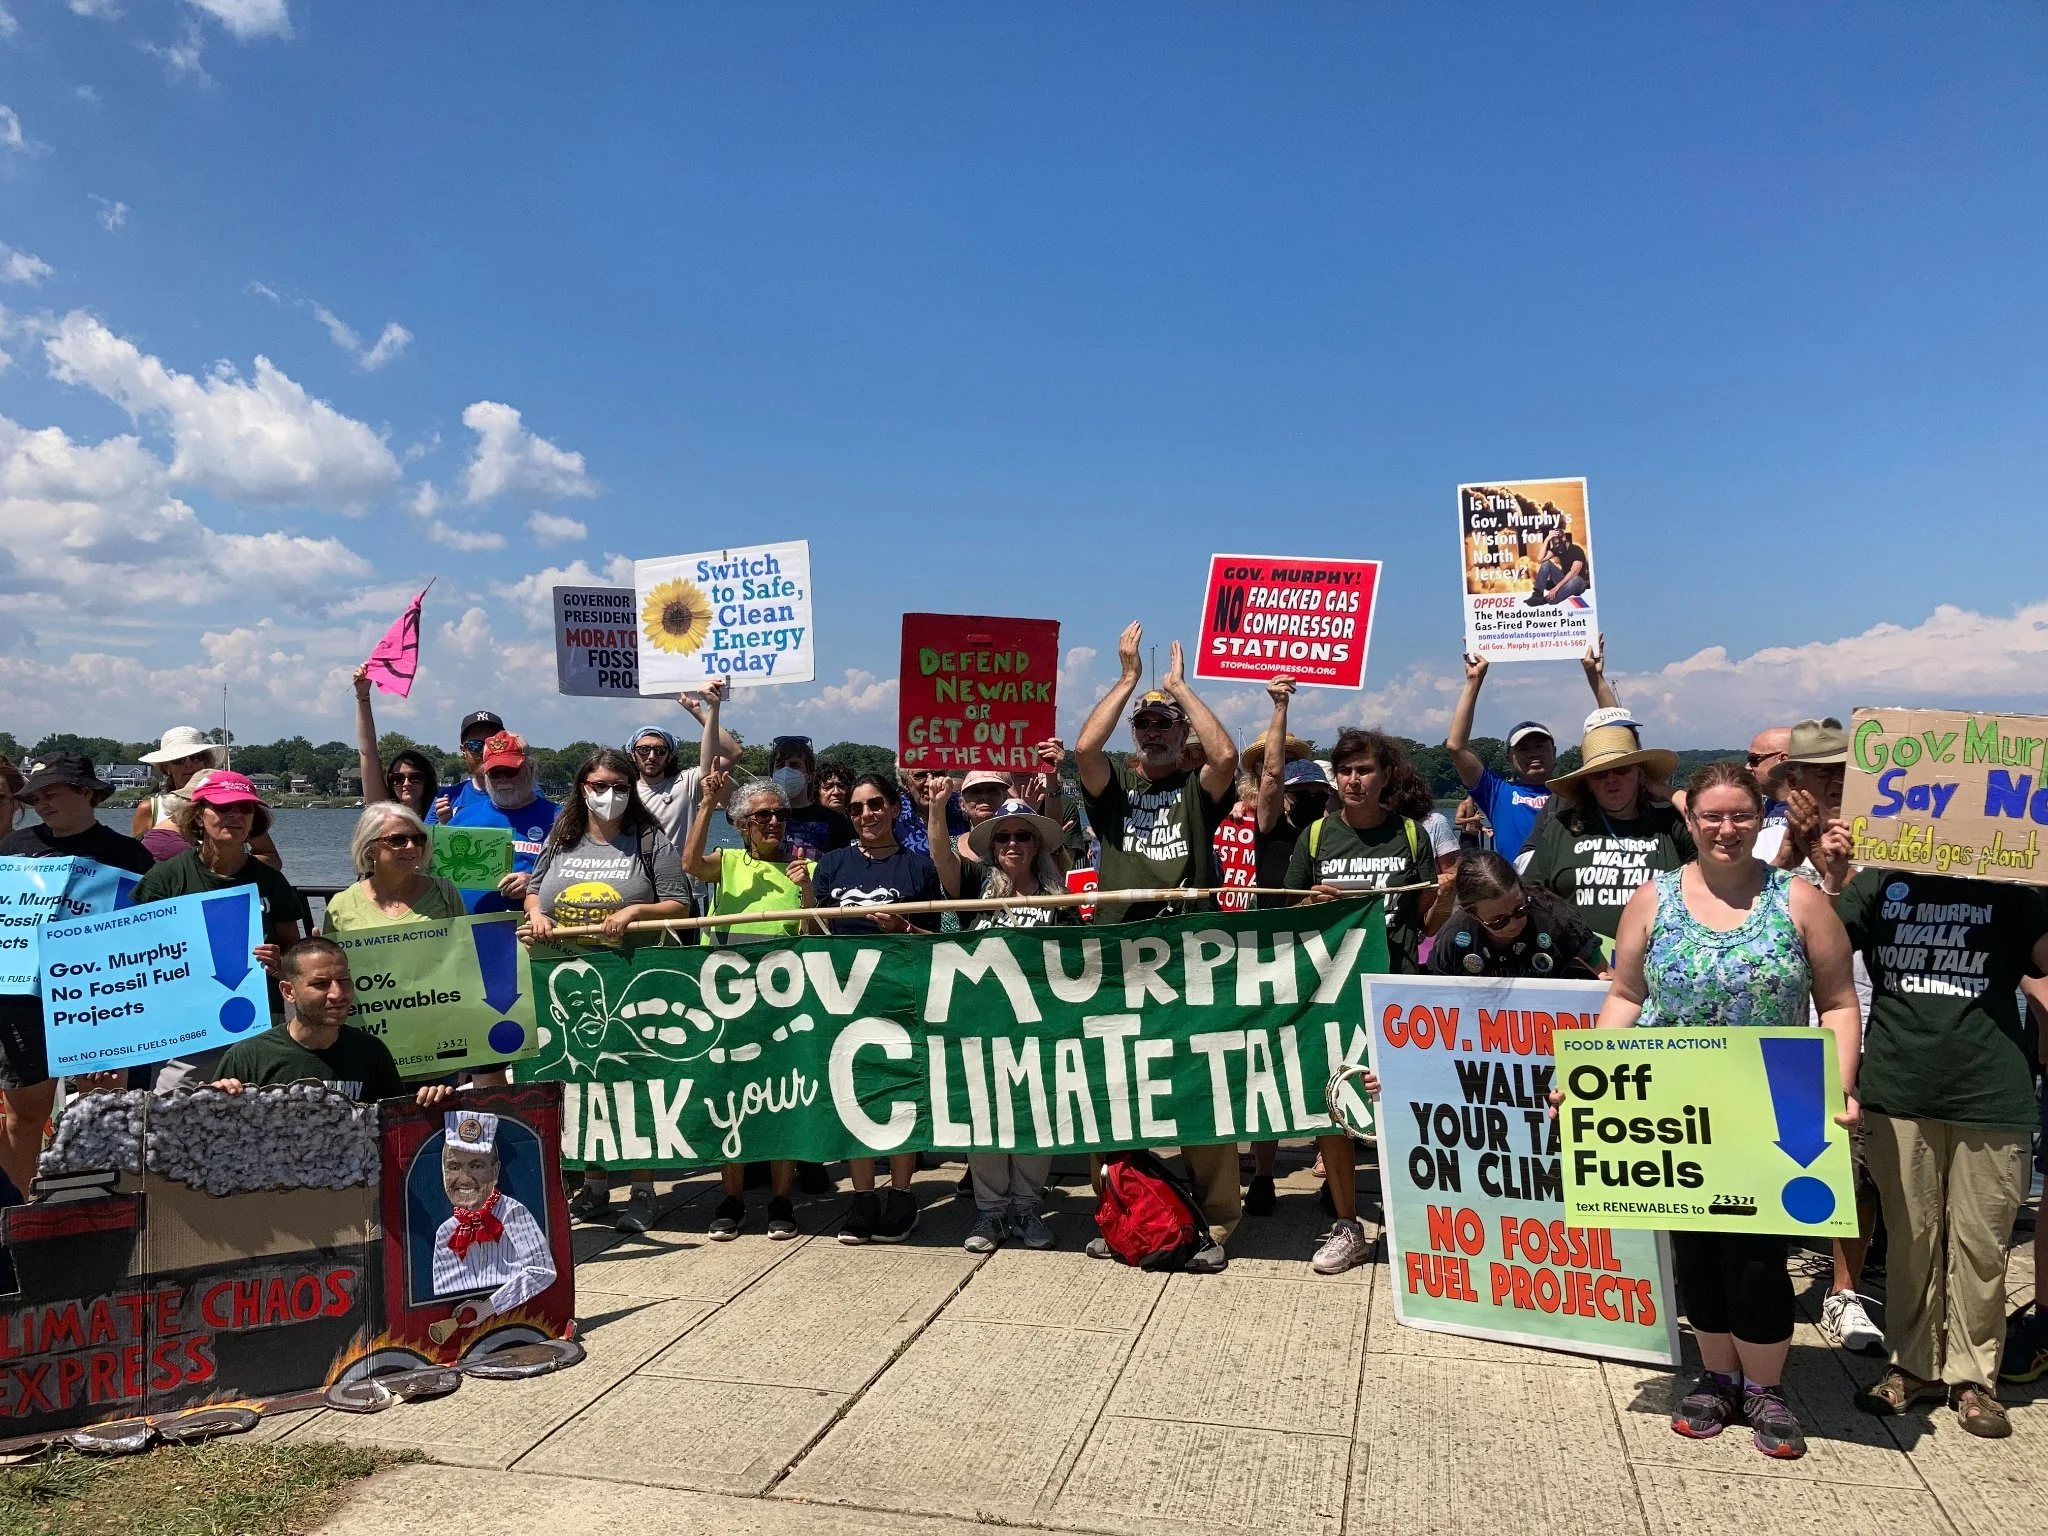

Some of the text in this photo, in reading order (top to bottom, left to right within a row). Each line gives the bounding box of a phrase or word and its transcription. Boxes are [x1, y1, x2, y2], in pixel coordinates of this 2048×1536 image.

[1470, 495, 1517, 512] Is This
[1471, 510, 1572, 530] Gov. Murphy's
[1472, 529, 1543, 546] Vision for
[697, 553, 780, 583] Switch
[1473, 550, 1514, 564] North
[1223, 567, 1362, 585] GOV. MURPHY!
[1474, 566, 1528, 582] Jersey?
[563, 593, 630, 608] GOVERNOR
[712, 576, 803, 604] to Safe,
[1213, 585, 1360, 633] NO FRACKED GAS
[1474, 597, 1515, 609] OPPOSE
[1475, 611, 1492, 620] The
[1496, 608, 1563, 619] Meadowlands
[719, 605, 795, 627] Clean
[1243, 612, 1356, 640] COMPRESSOR
[1475, 618, 1586, 631] Gas-Fired Power Plant
[713, 627, 805, 651] Energy
[1478, 630, 1586, 640] nomeadowlandspowerplant.com
[1507, 641, 1530, 650] Murphy
[919, 648, 1030, 675] DEFEND
[1211, 637, 1350, 662] STATIONS
[702, 651, 778, 676] Today
[1220, 661, 1336, 676] STOPtheCOMPRESSOR.ORG
[599, 670, 639, 689] PRO
[935, 676, 1052, 703] NEWARK
[965, 704, 991, 720] OR
[908, 716, 1029, 745] GET OUT
[905, 746, 1040, 768] OF THE WAY
[1854, 719, 1958, 774] Gov.
[1871, 768, 1960, 818] Say
[1151, 822, 1182, 846] TALK
[1574, 838, 1603, 854] GOV
[562, 858, 631, 868] FORWARD
[1592, 851, 1648, 867] WALK
[1936, 844, 1974, 872] gas
[1977, 830, 2040, 876] plant
[24, 864, 55, 873] WATER
[55, 863, 97, 878] ACTION!
[557, 869, 631, 880] TOGETHER!
[1321, 856, 1406, 875] GOV MURPHY
[1575, 867, 1622, 886] YOUR
[18, 892, 92, 916] Murphy:
[1576, 888, 1594, 906] ON
[46, 905, 177, 940] FOOD & WATER ACTION!
[1881, 901, 1993, 924] GOV MURPHY
[354, 939, 362, 947] &
[363, 934, 401, 946] WATER
[402, 928, 448, 942] ACTION!
[1894, 923, 1970, 947] WALK
[49, 941, 188, 978] Gov. Murphy:
[1877, 946, 1989, 974] YOUR TALK
[7, 975, 32, 983] FUELS
[51, 962, 190, 1002] No Fossil Fuel
[700, 927, 1367, 1024] GOV MURPHY
[53, 1001, 145, 1027] Projects
[1382, 1003, 1600, 1057] GOV. MUR
[57, 1029, 207, 1064] text NO FOSSIL FUELS to 69866
[436, 1038, 468, 1050] 23321
[1564, 1037, 1727, 1051] FOOD & WATER ACTION!
[424, 1054, 434, 1062] to
[703, 1068, 819, 1159] your
[828, 1013, 1178, 1152] CLIMATE
[1190, 1021, 1375, 1137] TALK
[1454, 1059, 1556, 1110] WALK
[1568, 1064, 1652, 1101] Off
[1409, 1101, 1512, 1153] YOUR
[1571, 1104, 1712, 1145] Fossil
[1408, 1145, 1461, 1193] ON
[1574, 1150, 1705, 1188] Fuels
[1576, 1202, 1705, 1215] text RENEWABLES to
[1712, 1194, 1756, 1206] 23321
[1427, 1204, 1621, 1272] NO FOSSIL
[201, 1269, 356, 1330] CHAOS
[1405, 1251, 1656, 1326] FUEL PROJECTS
